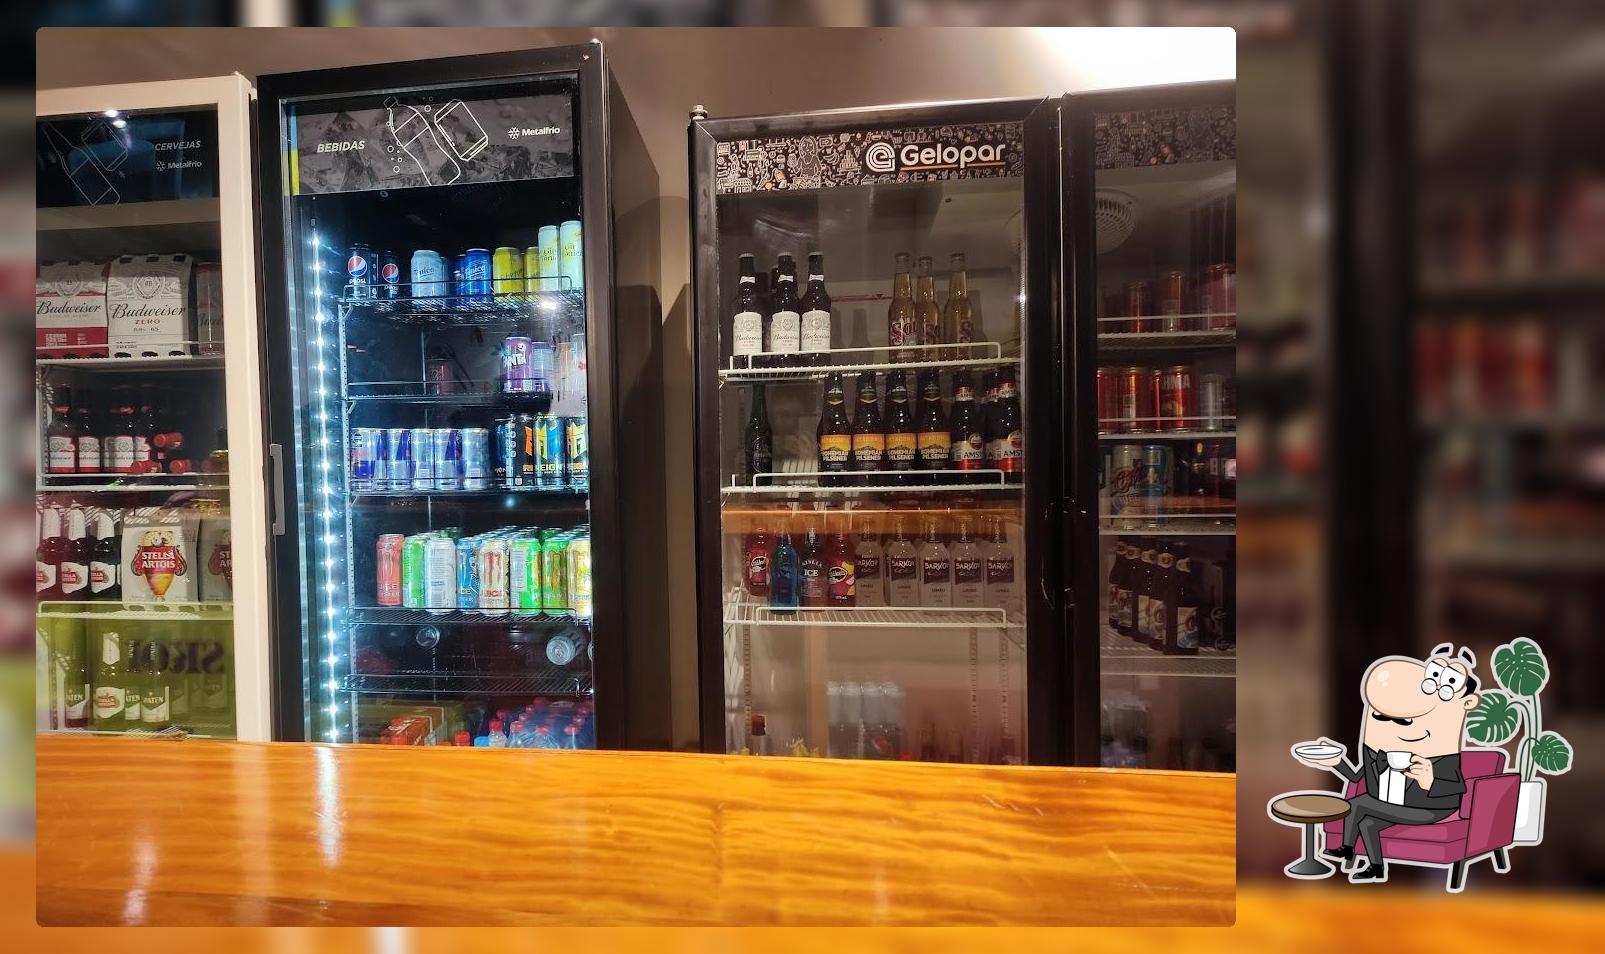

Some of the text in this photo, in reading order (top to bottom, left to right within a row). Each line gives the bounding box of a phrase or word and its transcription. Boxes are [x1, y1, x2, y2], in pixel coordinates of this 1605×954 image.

[522, 126, 561, 137] Metalfrio
[155, 140, 202, 151] CERVEJAS
[317, 140, 366, 153] BEBIDAS
[900, 143, 1006, 169] Gelopar
[168, 160, 203, 170] Metalfrio
[37, 300, 102, 315] Budweiser
[111, 303, 188, 319] Budweiser
[142, 551, 175, 561] STELLA
[142, 560, 175, 569] ARTOIS
[804, 569, 819, 577] ICE
[126, 694, 141, 703] ATEN
